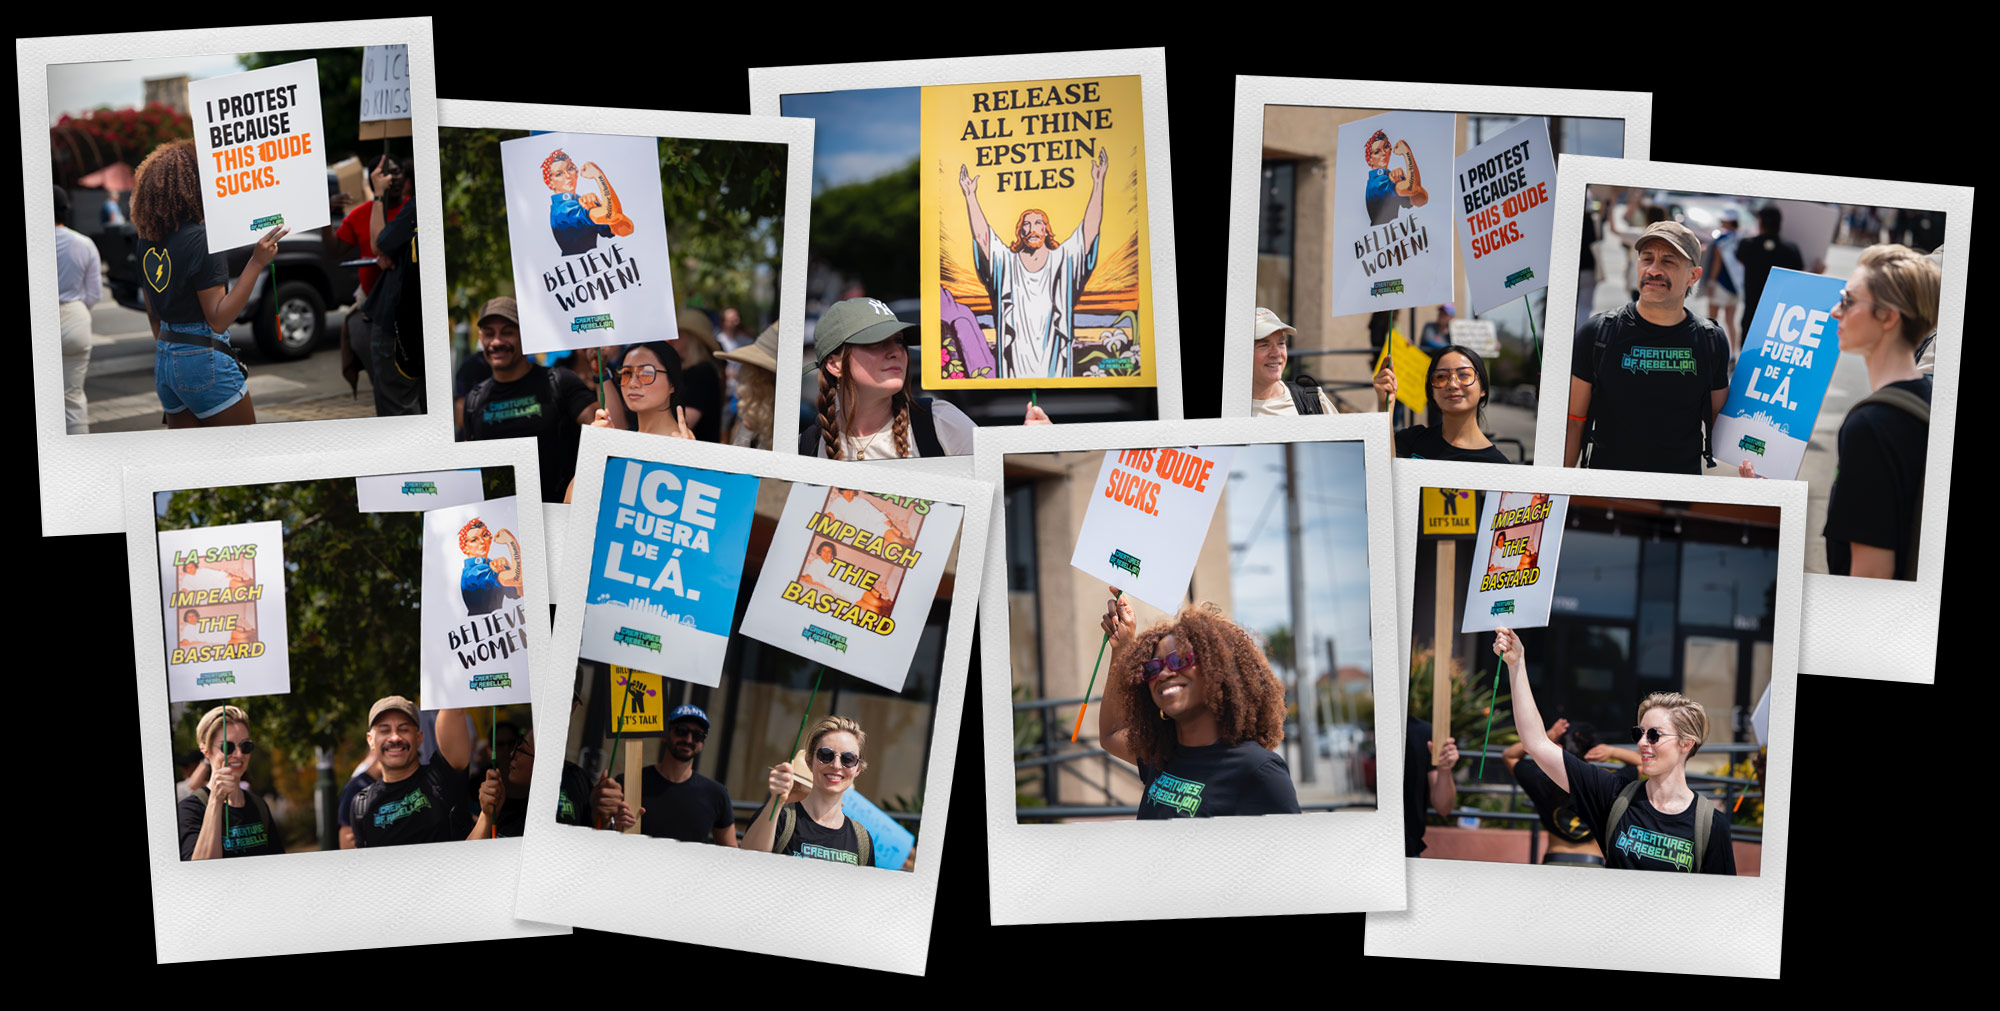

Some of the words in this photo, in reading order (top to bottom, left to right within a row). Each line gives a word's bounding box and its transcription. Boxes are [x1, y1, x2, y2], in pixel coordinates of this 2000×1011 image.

[206, 100, 214, 123] I
[218, 84, 298, 121] PROTEST
[373, 87, 411, 115] KINGS
[972, 82, 1100, 113] RELEASE
[209, 112, 291, 148] BECAUSE
[960, 118, 1013, 141] ALL
[1021, 108, 1113, 136] THINE
[212, 145, 255, 173] THIS
[258, 132, 312, 163] DUDE
[976, 138, 1097, 167] EPSTEIN
[1459, 174, 1466, 193] I
[1468, 140, 1530, 188] PROTEST
[215, 166, 280, 198] SUCKS.
[997, 167, 1075, 193] FILES
[1463, 167, 1527, 215] BECAUSE
[1466, 205, 1501, 236] THIS
[1500, 181, 1549, 219] DUDE
[1354, 213, 1419, 259] BELIEVE
[1361, 226, 1430, 277] WOMEN!
[1471, 220, 1524, 260] SUCKS.
[542, 243, 624, 292] BELIEVE
[555, 257, 642, 312] WOMEN!
[1766, 302, 1830, 349] ICE
[1624, 357, 1638, 369] OF
[1639, 359, 1695, 370] REBELLION
[1632, 348, 1691, 360] CREATURES
[1760, 340, 1814, 370] FUERA
[1764, 364, 1781, 380] DE
[1744, 367, 1799, 411] L.Á.
[1156, 448, 1215, 493] DUDE
[618, 460, 722, 530] ICE
[1105, 468, 1161, 517] SUCKS.
[615, 506, 710, 553] FUERA
[1429, 517, 1449, 527] LET'S
[1452, 517, 1470, 527] TALK
[1490, 500, 1553, 531] IMPEACH
[173, 549, 199, 567] LA
[204, 543, 258, 563] SAYS
[631, 540, 660, 561] DE
[806, 512, 922, 569] IMPEACH
[1502, 536, 1530, 558] THE
[603, 541, 701, 601] L.Á.
[828, 558, 881, 592] THE
[1480, 566, 1540, 592] BASTARD
[169, 584, 264, 608] IMPEACH
[781, 580, 896, 636] BASTARD
[199, 614, 239, 634] THE
[448, 604, 526, 650] BELIEVE
[170, 641, 266, 665] BASTARD
[617, 715, 637, 725] LT'S
[639, 715, 658, 725] TALK
[1149, 783, 1157, 798] OF
[1155, 788, 1200, 811] REBELLION
[1157, 775, 1202, 796] CREATURES
[803, 845, 859, 866] CREATURES
[1618, 835, 1634, 850] OF
[1633, 841, 1693, 868] REBELLION
[1629, 828, 1692, 853] CREATURES
